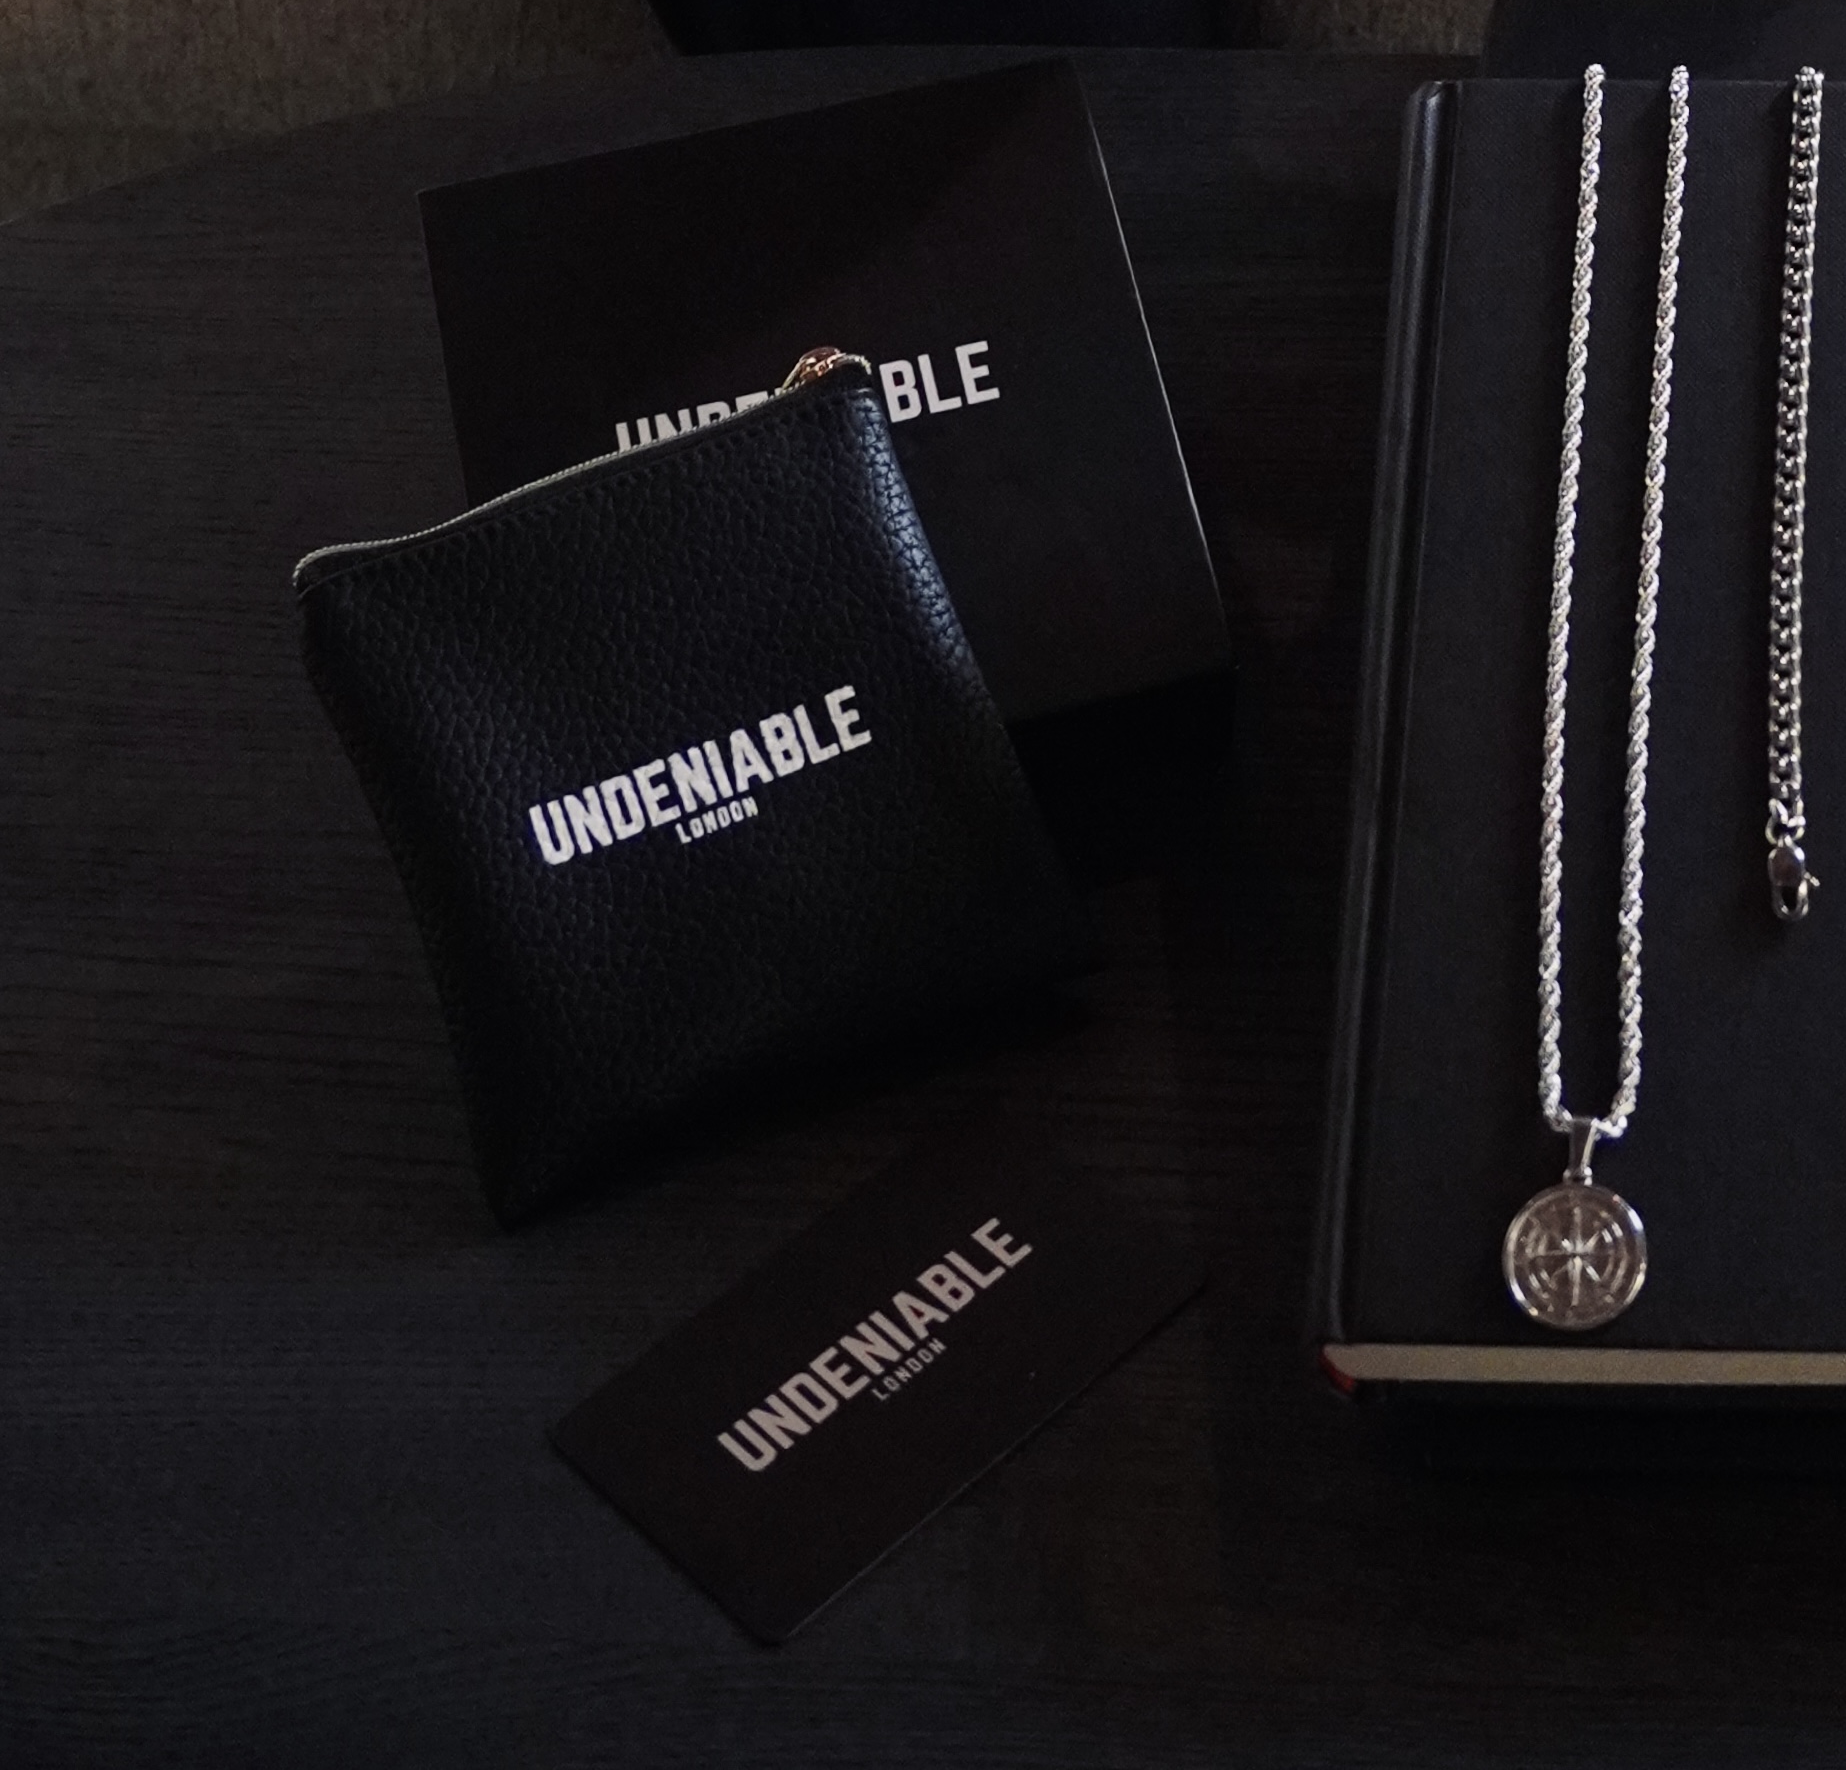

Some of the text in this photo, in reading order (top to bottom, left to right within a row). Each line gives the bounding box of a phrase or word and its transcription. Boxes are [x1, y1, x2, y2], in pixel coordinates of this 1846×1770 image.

[527, 684, 873, 867] UNDENIABLE
[673, 795, 760, 846] LONDON
[716, 1216, 1034, 1473] UNDENIABLE
[870, 1337, 948, 1403] LONDON
